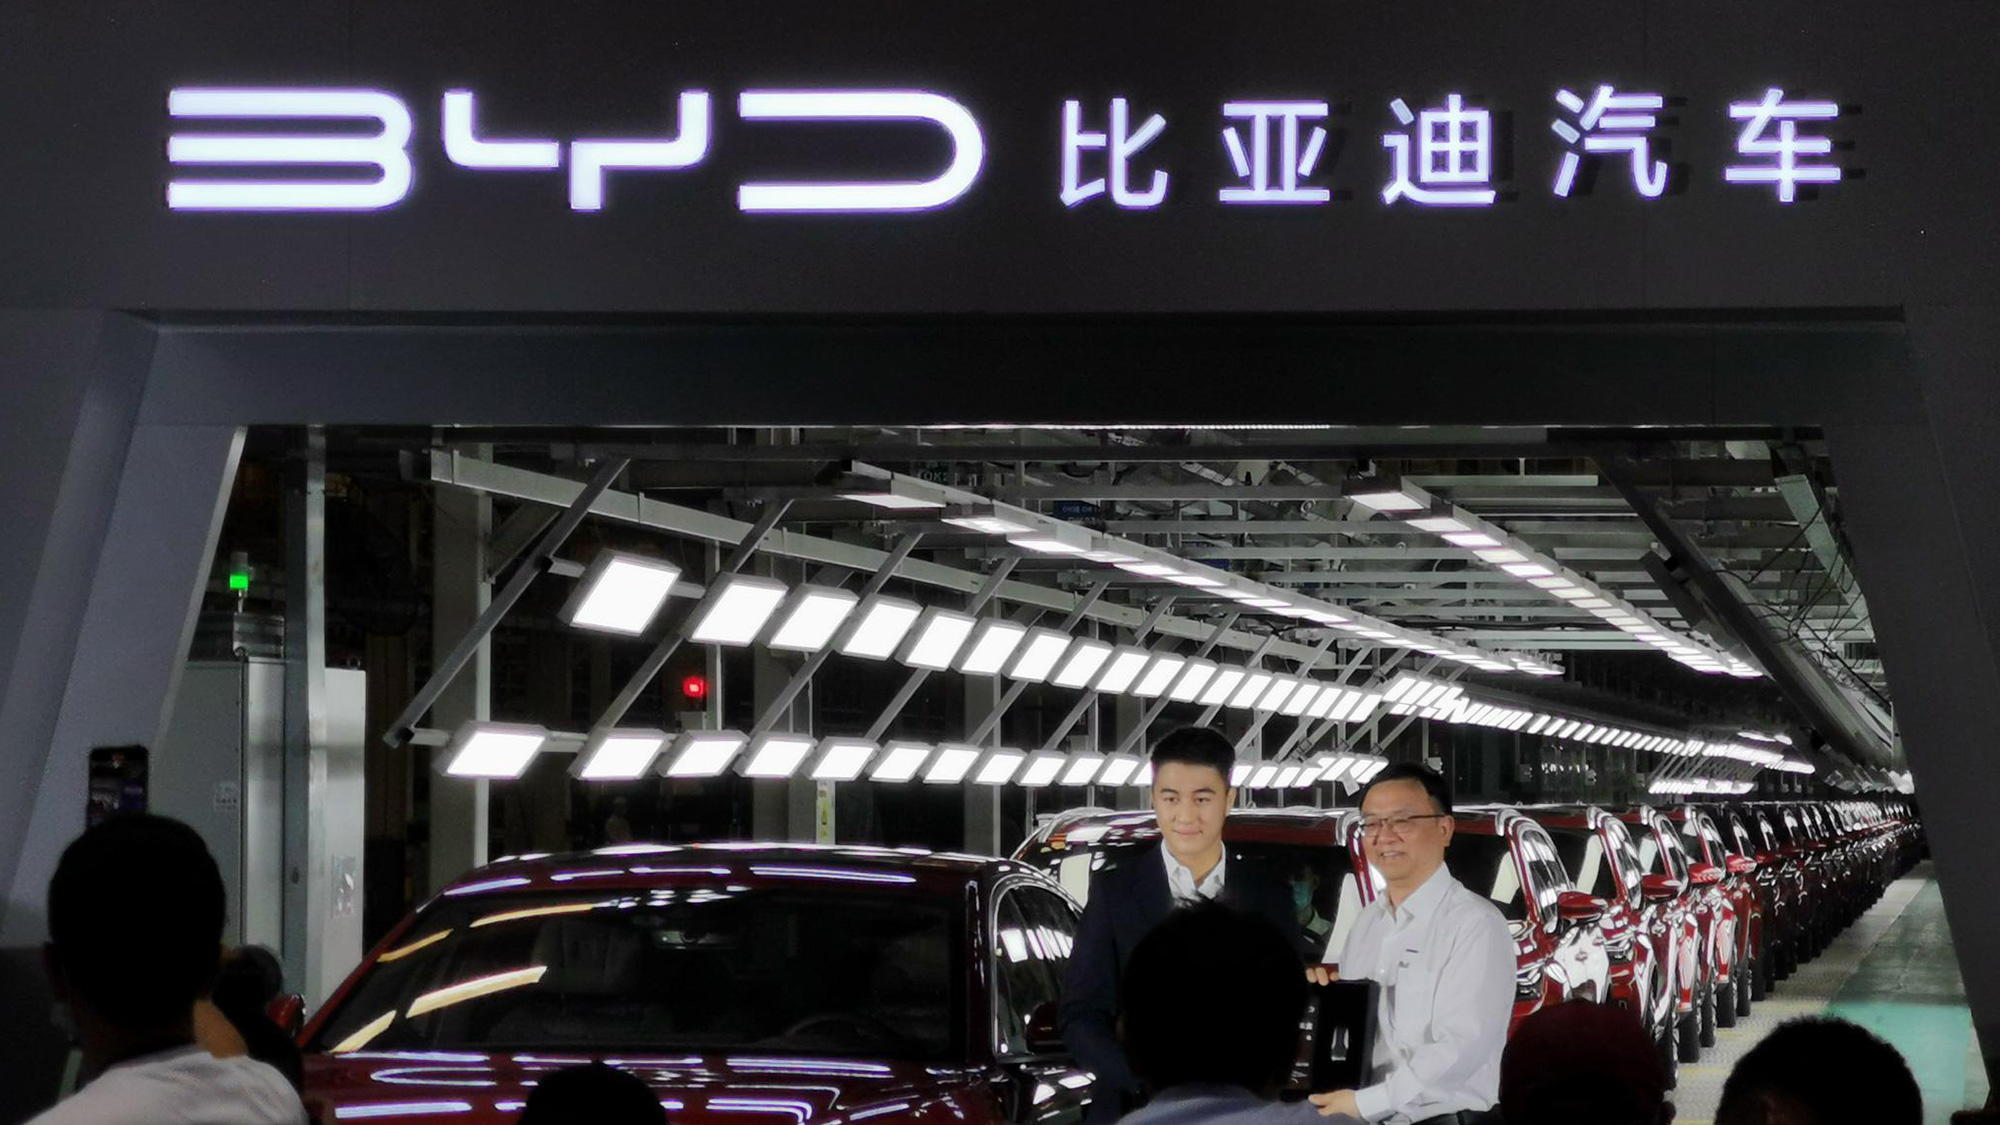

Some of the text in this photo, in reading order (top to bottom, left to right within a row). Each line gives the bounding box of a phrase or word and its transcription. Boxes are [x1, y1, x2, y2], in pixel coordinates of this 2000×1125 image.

[167, 85, 1841, 211] BYD 比亚迪汽车
